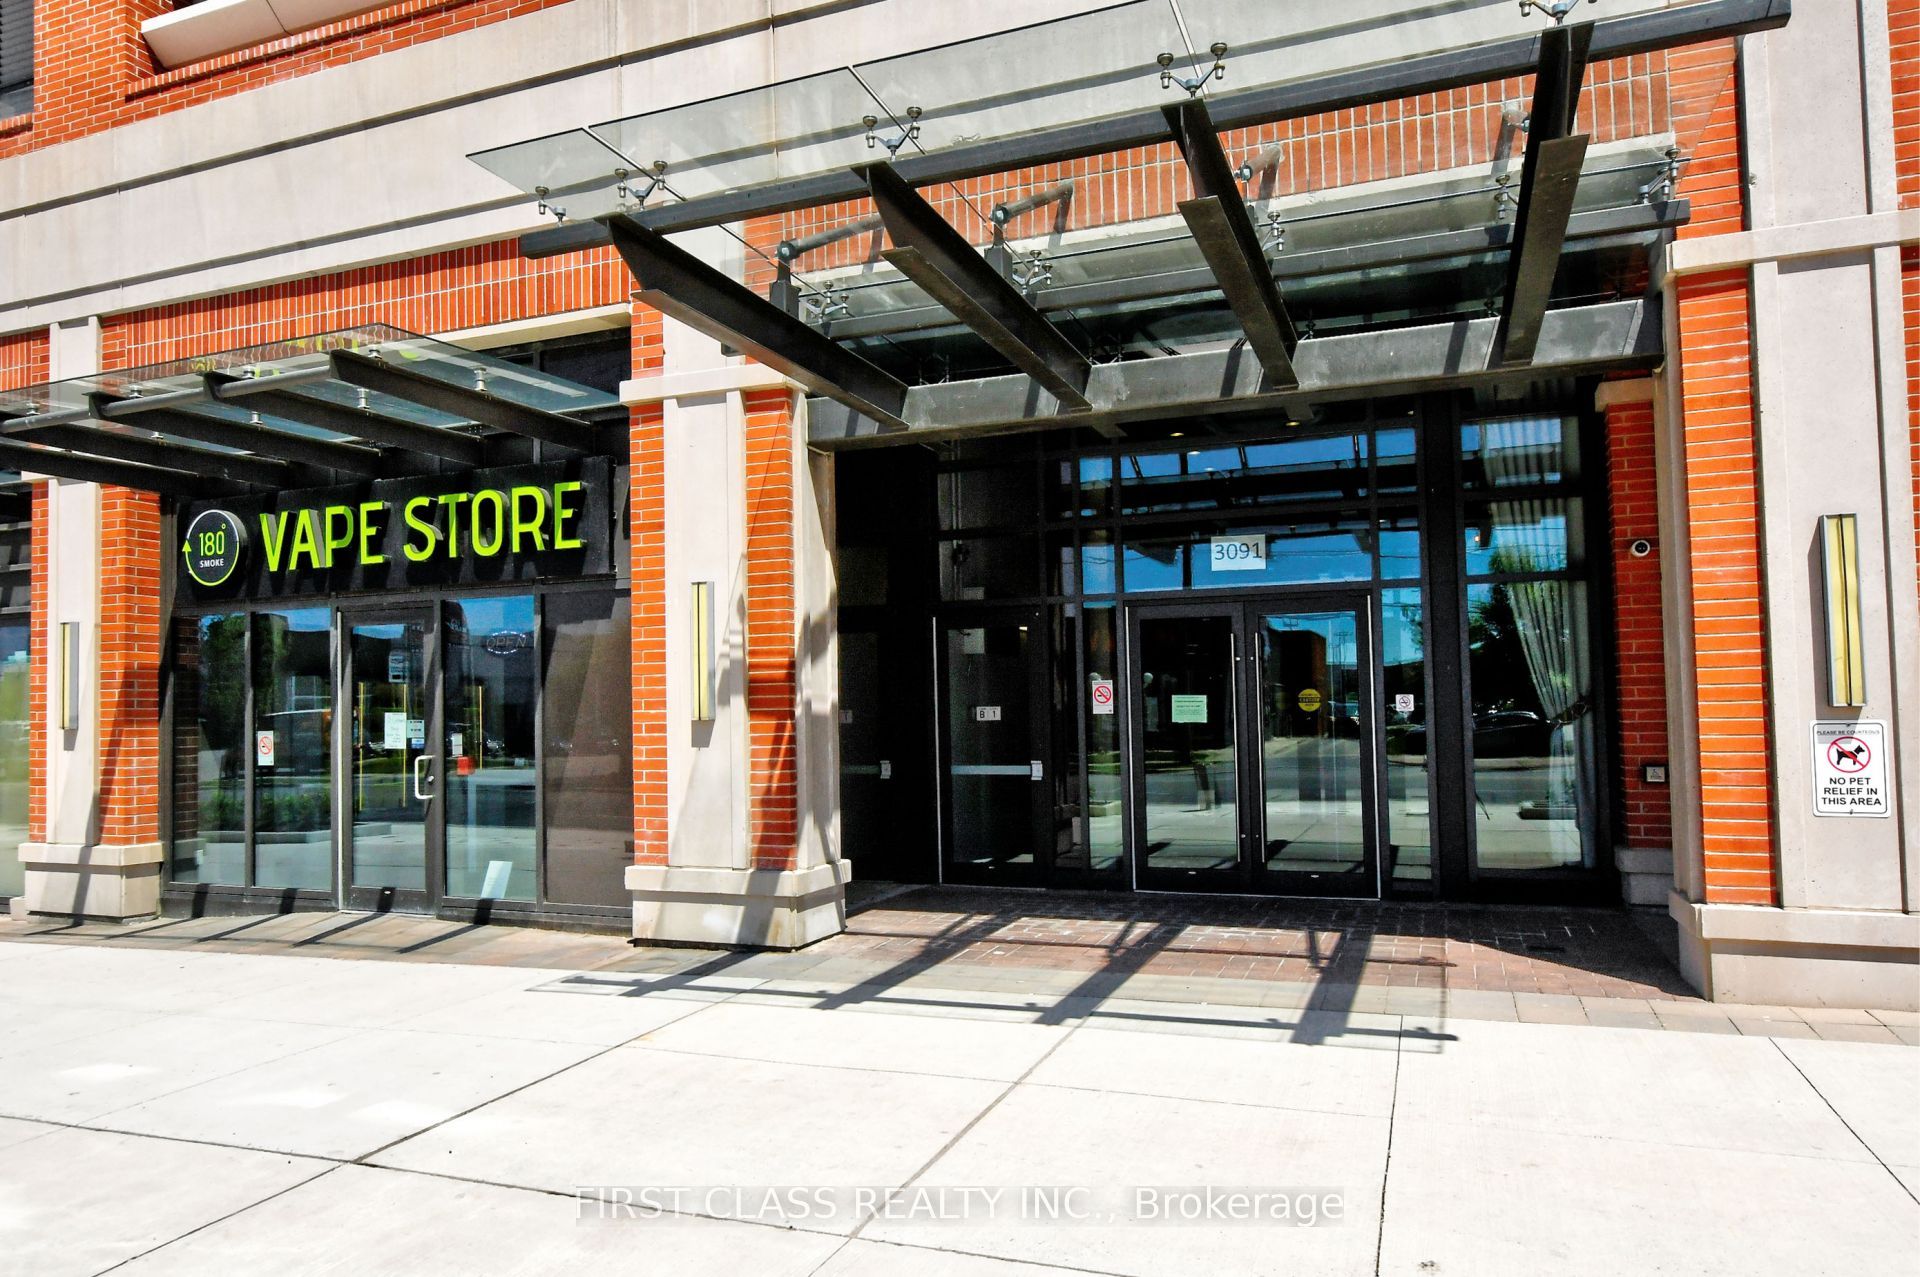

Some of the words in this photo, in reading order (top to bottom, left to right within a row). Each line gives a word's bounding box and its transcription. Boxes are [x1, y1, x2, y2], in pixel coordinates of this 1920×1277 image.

[259, 501, 384, 572] VAPE
[403, 481, 581, 562] STORE
[1214, 541, 1263, 561] 3091
[199, 558, 225, 568] SMOKE
[486, 635, 527, 649] OPEN
[979, 710, 986, 719] B
[1829, 777, 1846, 785] NO
[1849, 777, 1871, 786] PET
[1823, 787, 1863, 795] RELIEF
[1867, 787, 1878, 796] IN
[1821, 797, 1847, 805] THIS
[1849, 797, 1882, 806] AREA
